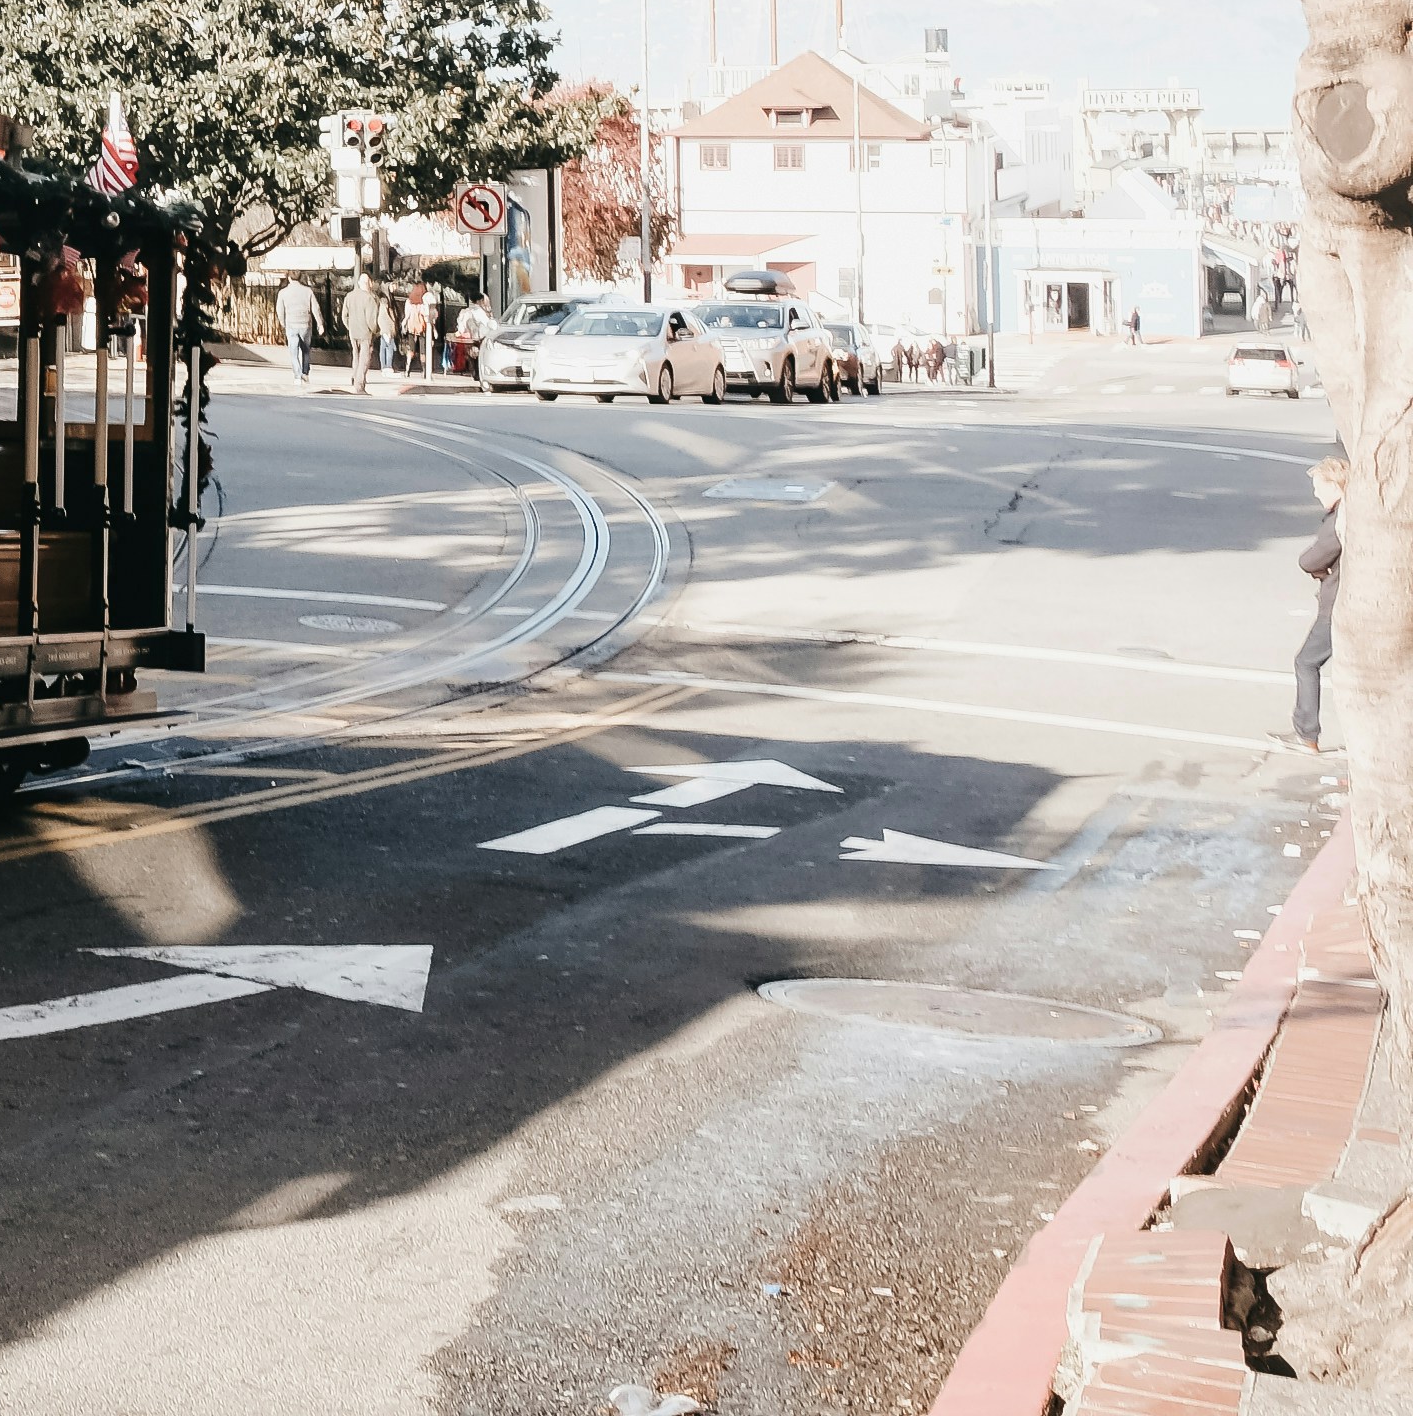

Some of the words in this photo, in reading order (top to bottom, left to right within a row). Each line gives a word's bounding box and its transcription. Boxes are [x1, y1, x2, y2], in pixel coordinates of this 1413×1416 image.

[1088, 91, 1127, 105] HYDE
[1133, 91, 1151, 105] ST
[1157, 90, 1191, 104] PIER
